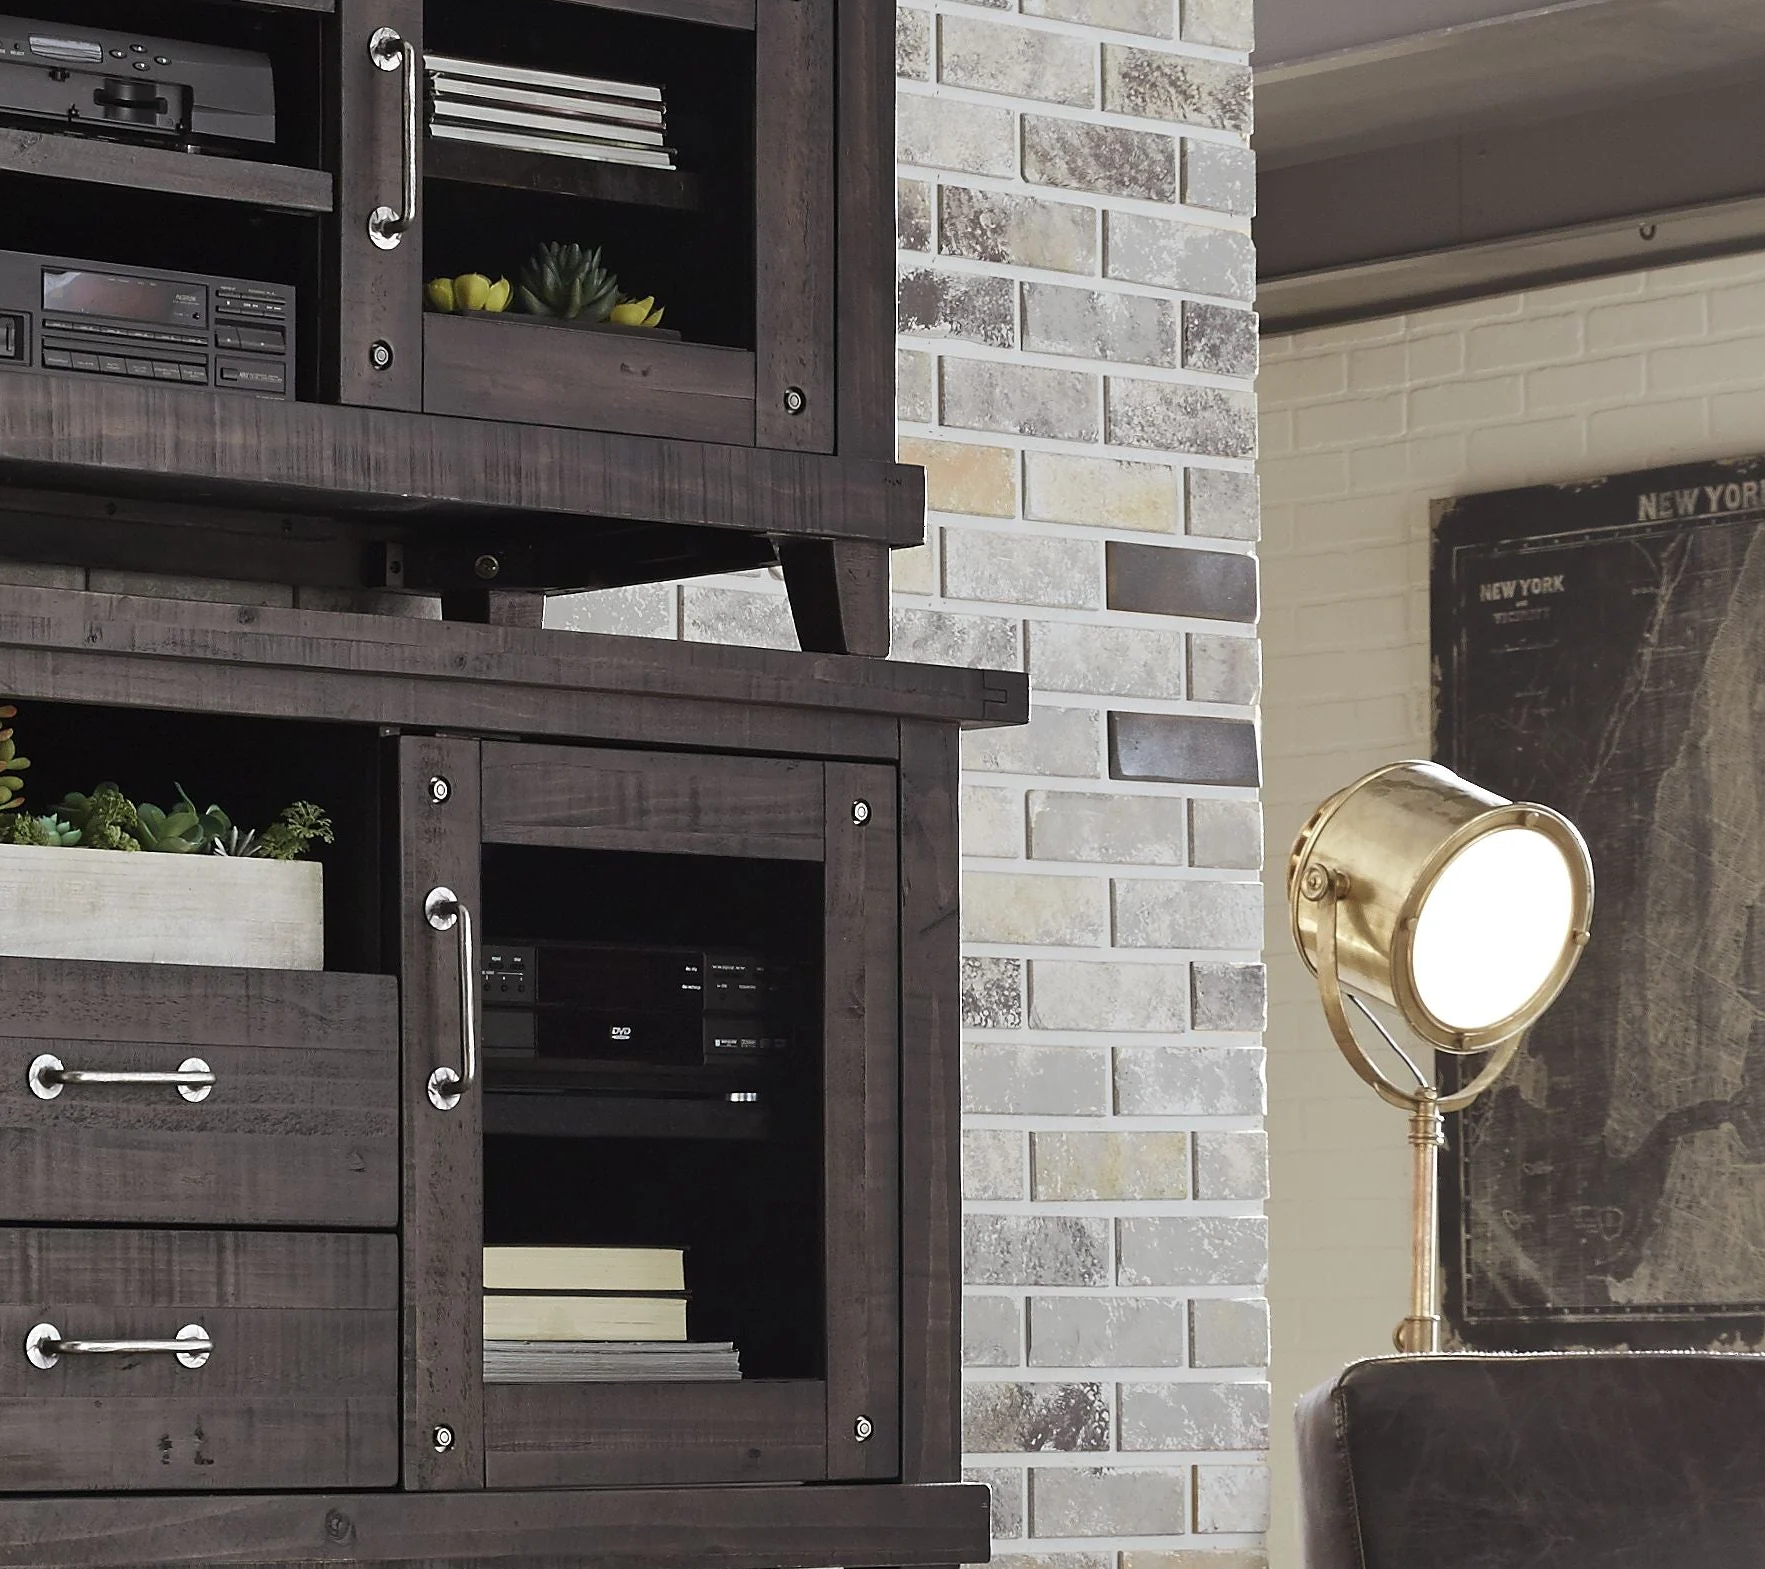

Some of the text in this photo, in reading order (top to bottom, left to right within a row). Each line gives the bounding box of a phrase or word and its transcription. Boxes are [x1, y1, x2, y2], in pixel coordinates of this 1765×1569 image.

[1637, 487, 1700, 521] NEW
[1479, 574, 1565, 602] NEW YORK
